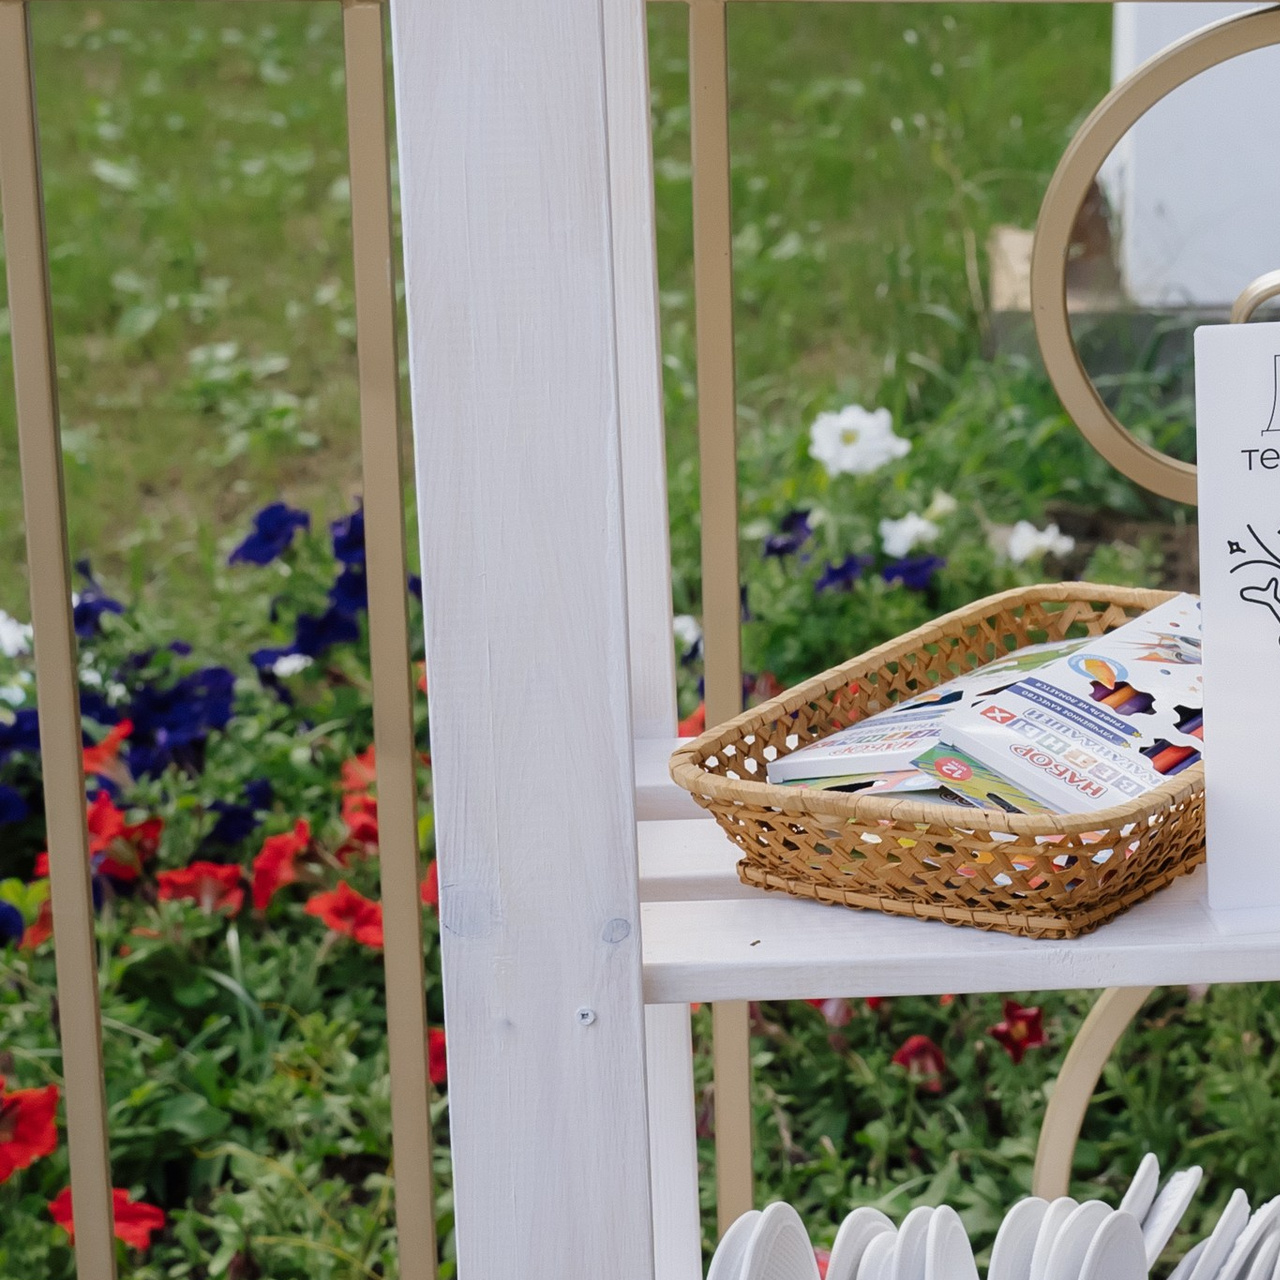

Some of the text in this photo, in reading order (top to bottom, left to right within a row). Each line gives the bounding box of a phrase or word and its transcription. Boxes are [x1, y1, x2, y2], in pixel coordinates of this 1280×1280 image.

[1021, 689, 1115, 740] УЛУЧШЕННОЕ КАЧЕСТВО
[1075, 701, 1089, 711] НЕ
[941, 763, 963, 779] 12
[1011, 744, 1107, 798] НАБОР
